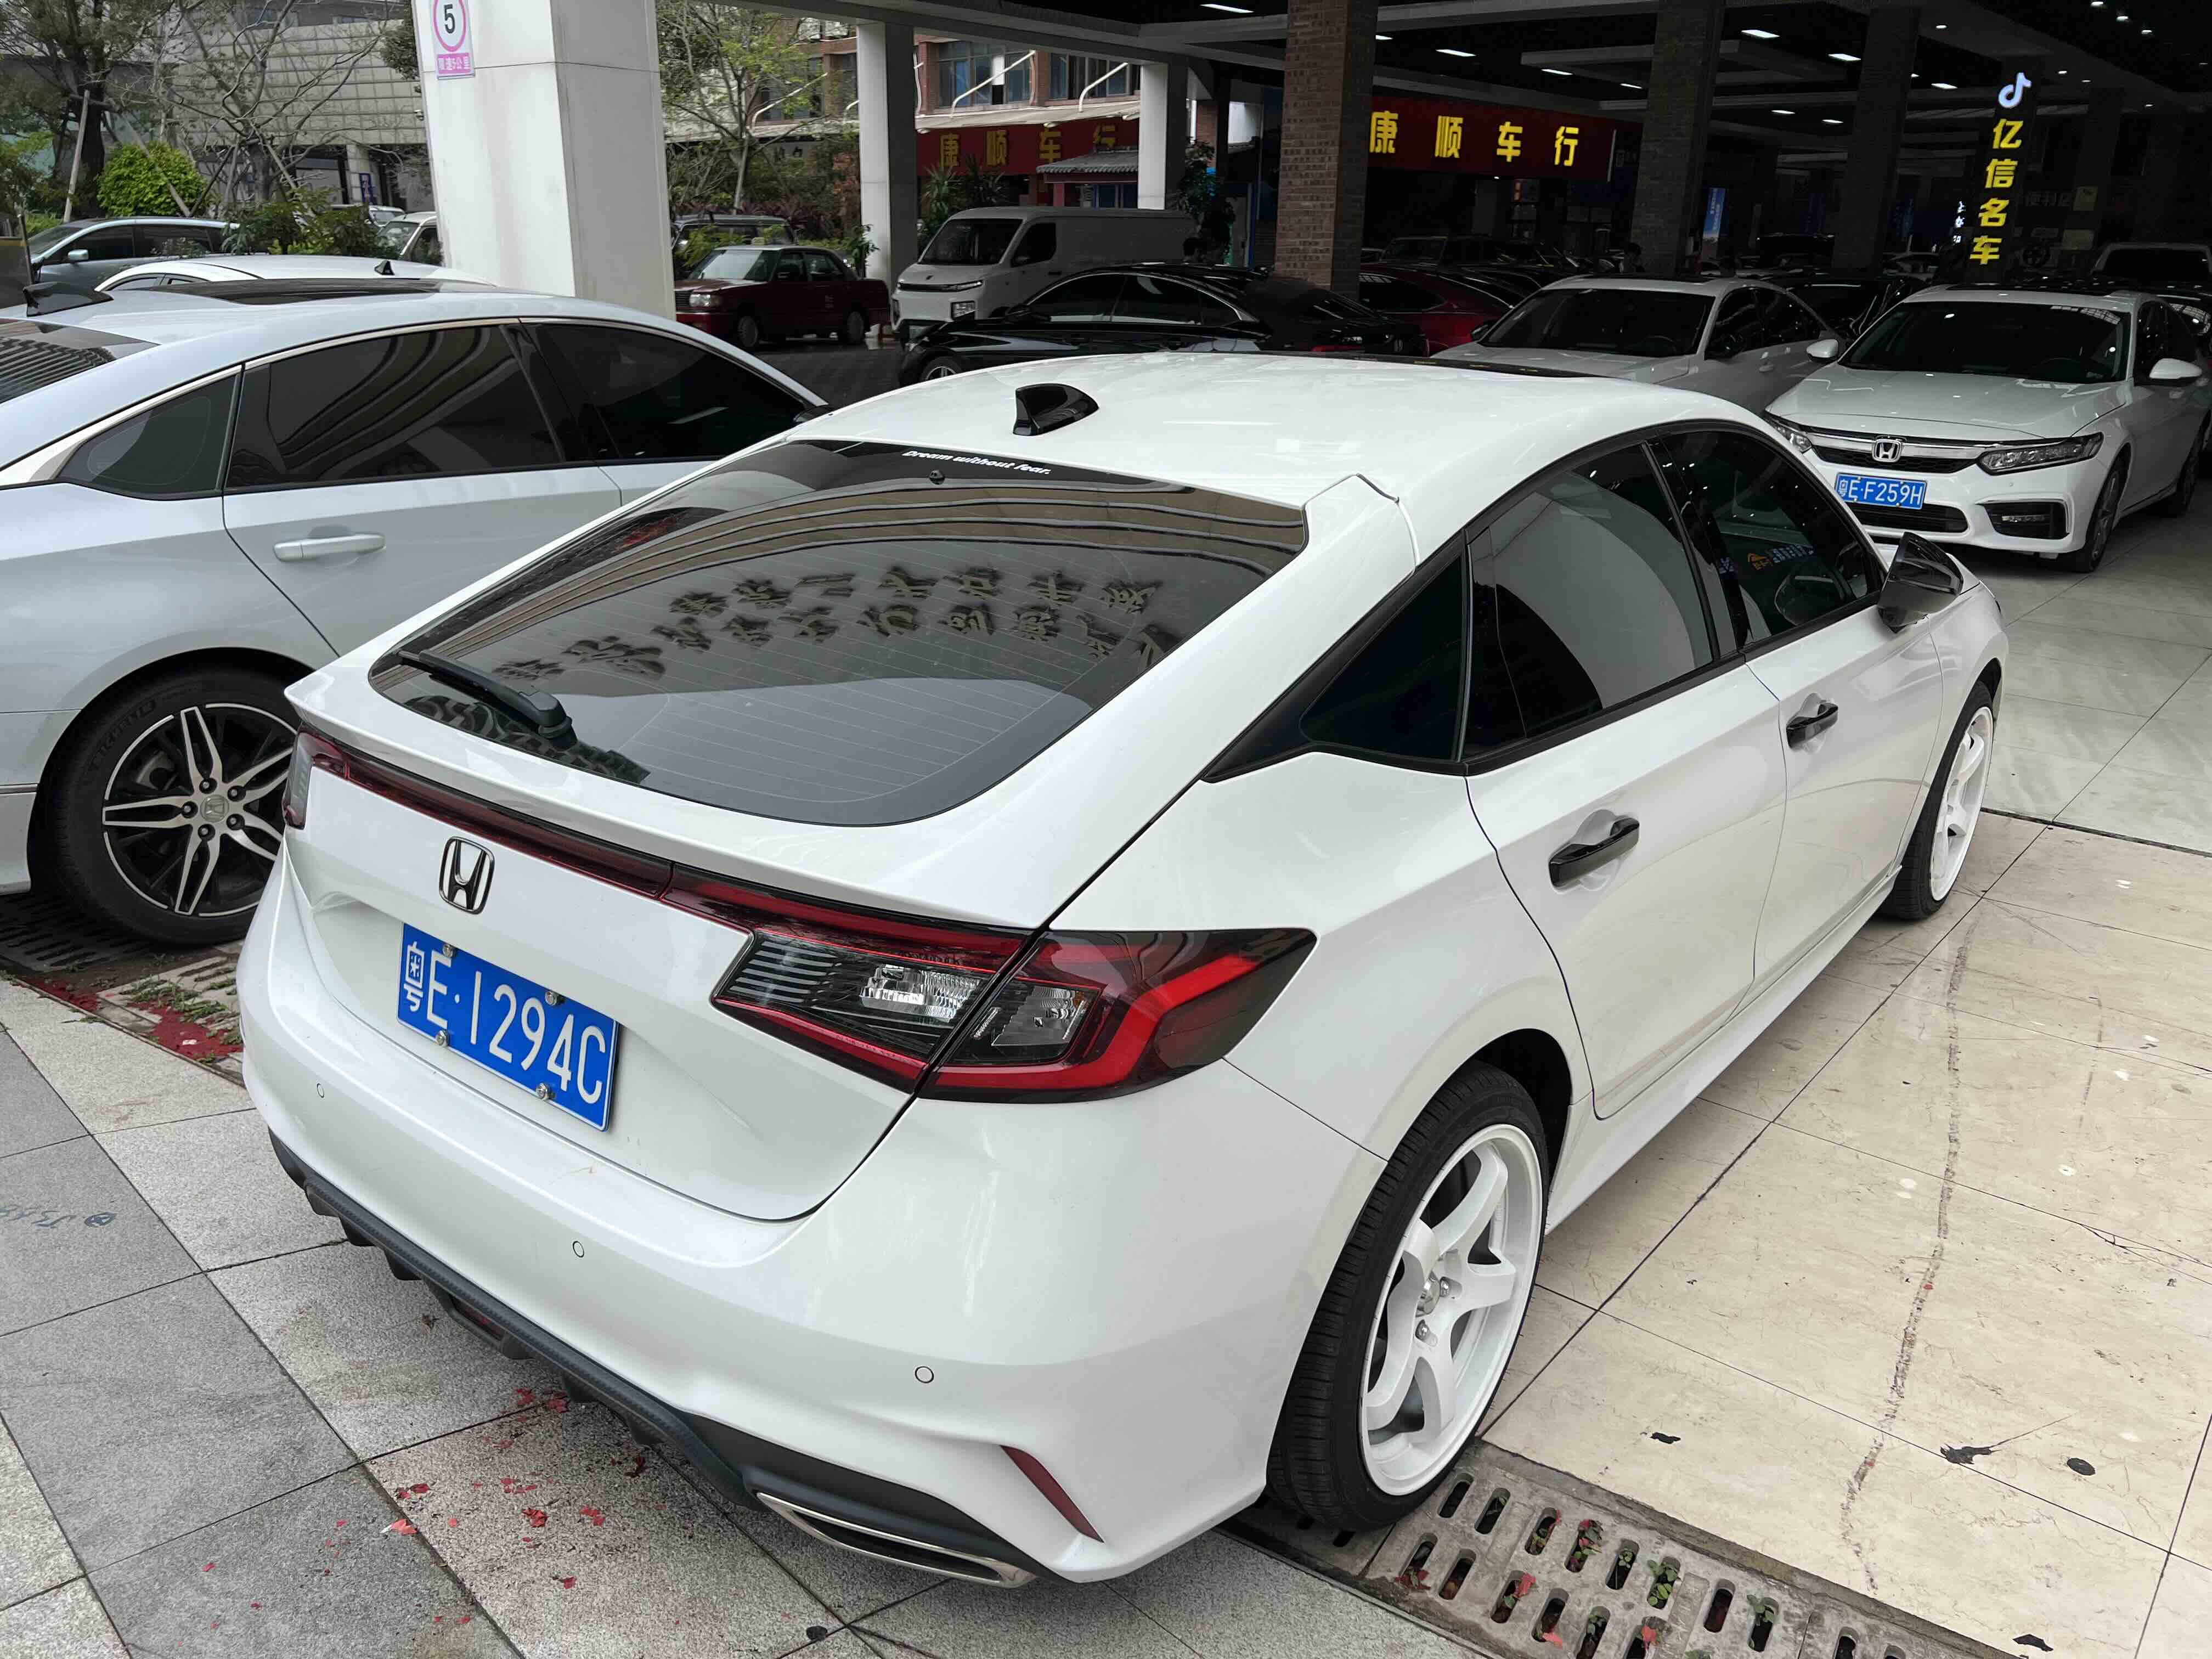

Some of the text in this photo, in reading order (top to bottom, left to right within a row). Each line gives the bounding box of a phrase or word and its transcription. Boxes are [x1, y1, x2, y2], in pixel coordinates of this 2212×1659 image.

[443, 4, 455, 33] 5
[1369, 110, 1579, 167] 康顺车行
[1969, 118, 2024, 266] 亿信名车
[901, 450, 953, 460] Dream
[953, 456, 1015, 468] without
